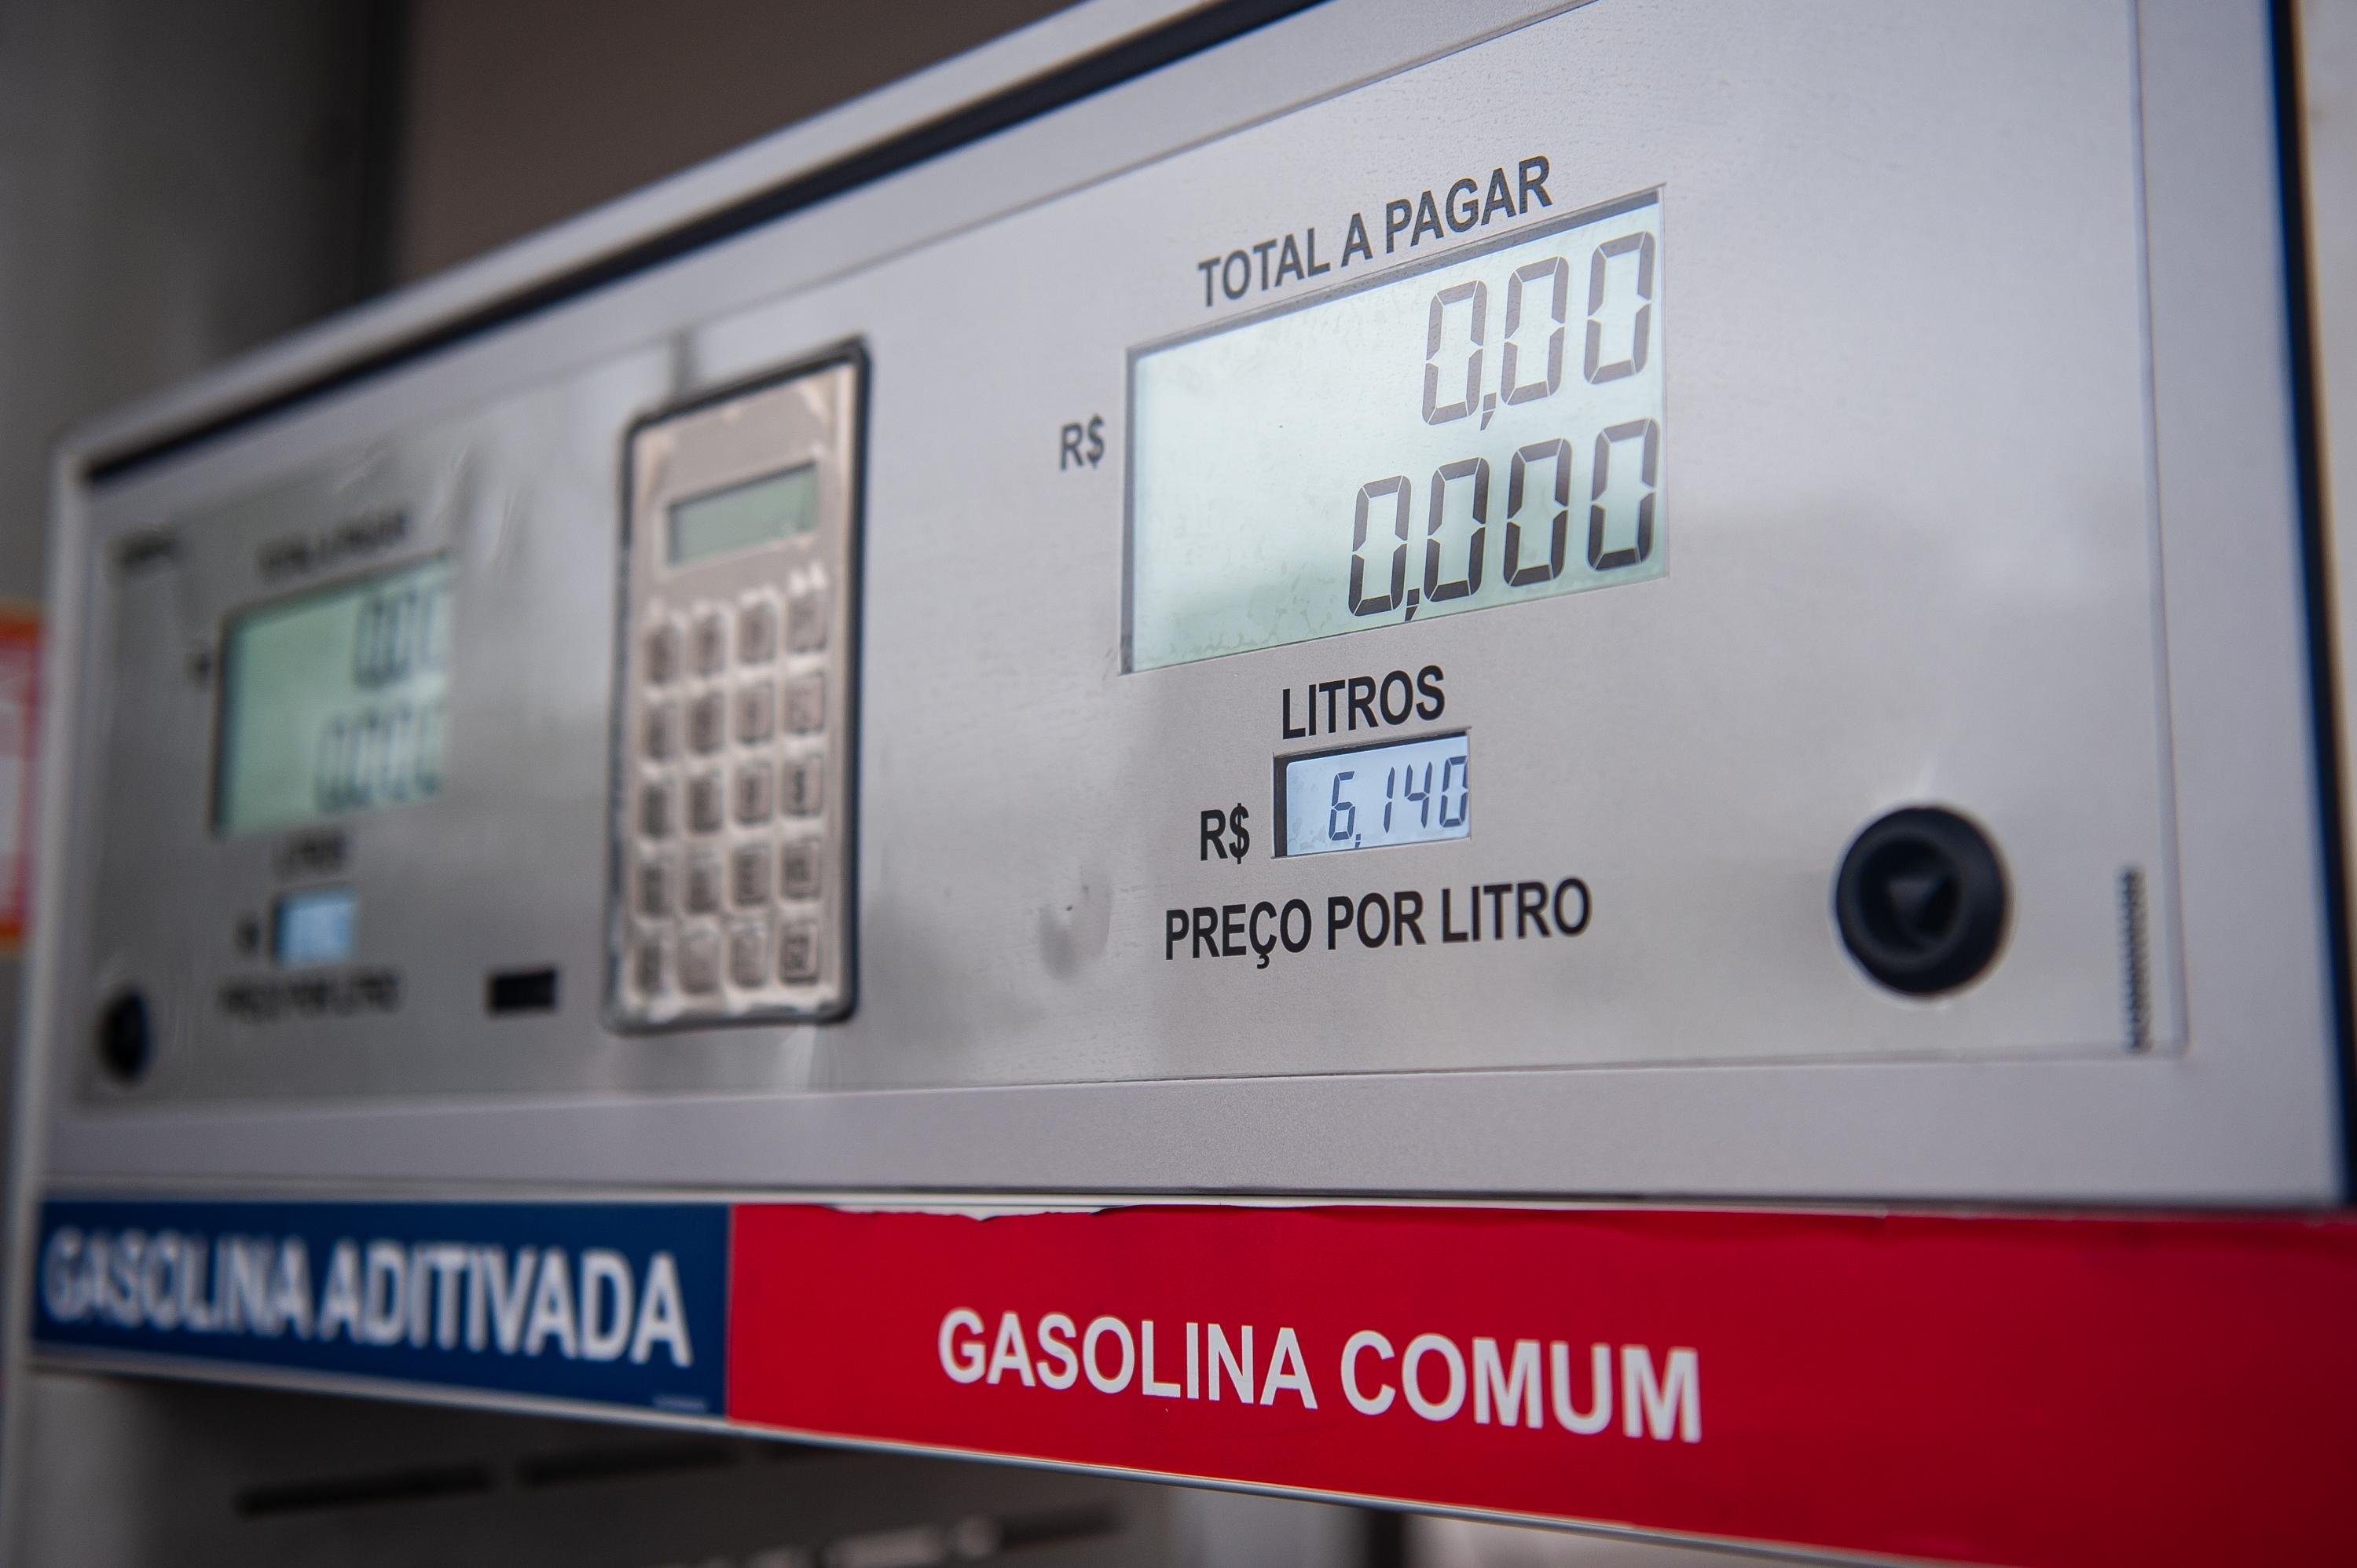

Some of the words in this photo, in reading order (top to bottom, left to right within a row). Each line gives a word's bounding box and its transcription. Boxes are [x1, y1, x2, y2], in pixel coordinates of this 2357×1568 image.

[1198, 225, 1330, 307] TOTAL
[1341, 212, 1373, 268] A
[1385, 155, 1552, 254] PAGAR
[1421, 230, 1655, 431] 0,00
[1060, 414, 1105, 470] R$
[1348, 417, 1660, 621] 0,000
[1281, 665, 1446, 740] LITROS
[1200, 802, 1250, 864] R$
[1328, 755, 1468, 848] 6,140
[1165, 897, 1312, 969] PREÇO
[1327, 891, 1426, 950] POR
[1441, 877, 1592, 943] LITRO
[42, 1225, 315, 1339] GASOLINA
[317, 1236, 694, 1368] ADITIVADA
[938, 1306, 1318, 1409] GASOLINA
[1340, 1329, 1703, 1444] COMUM
